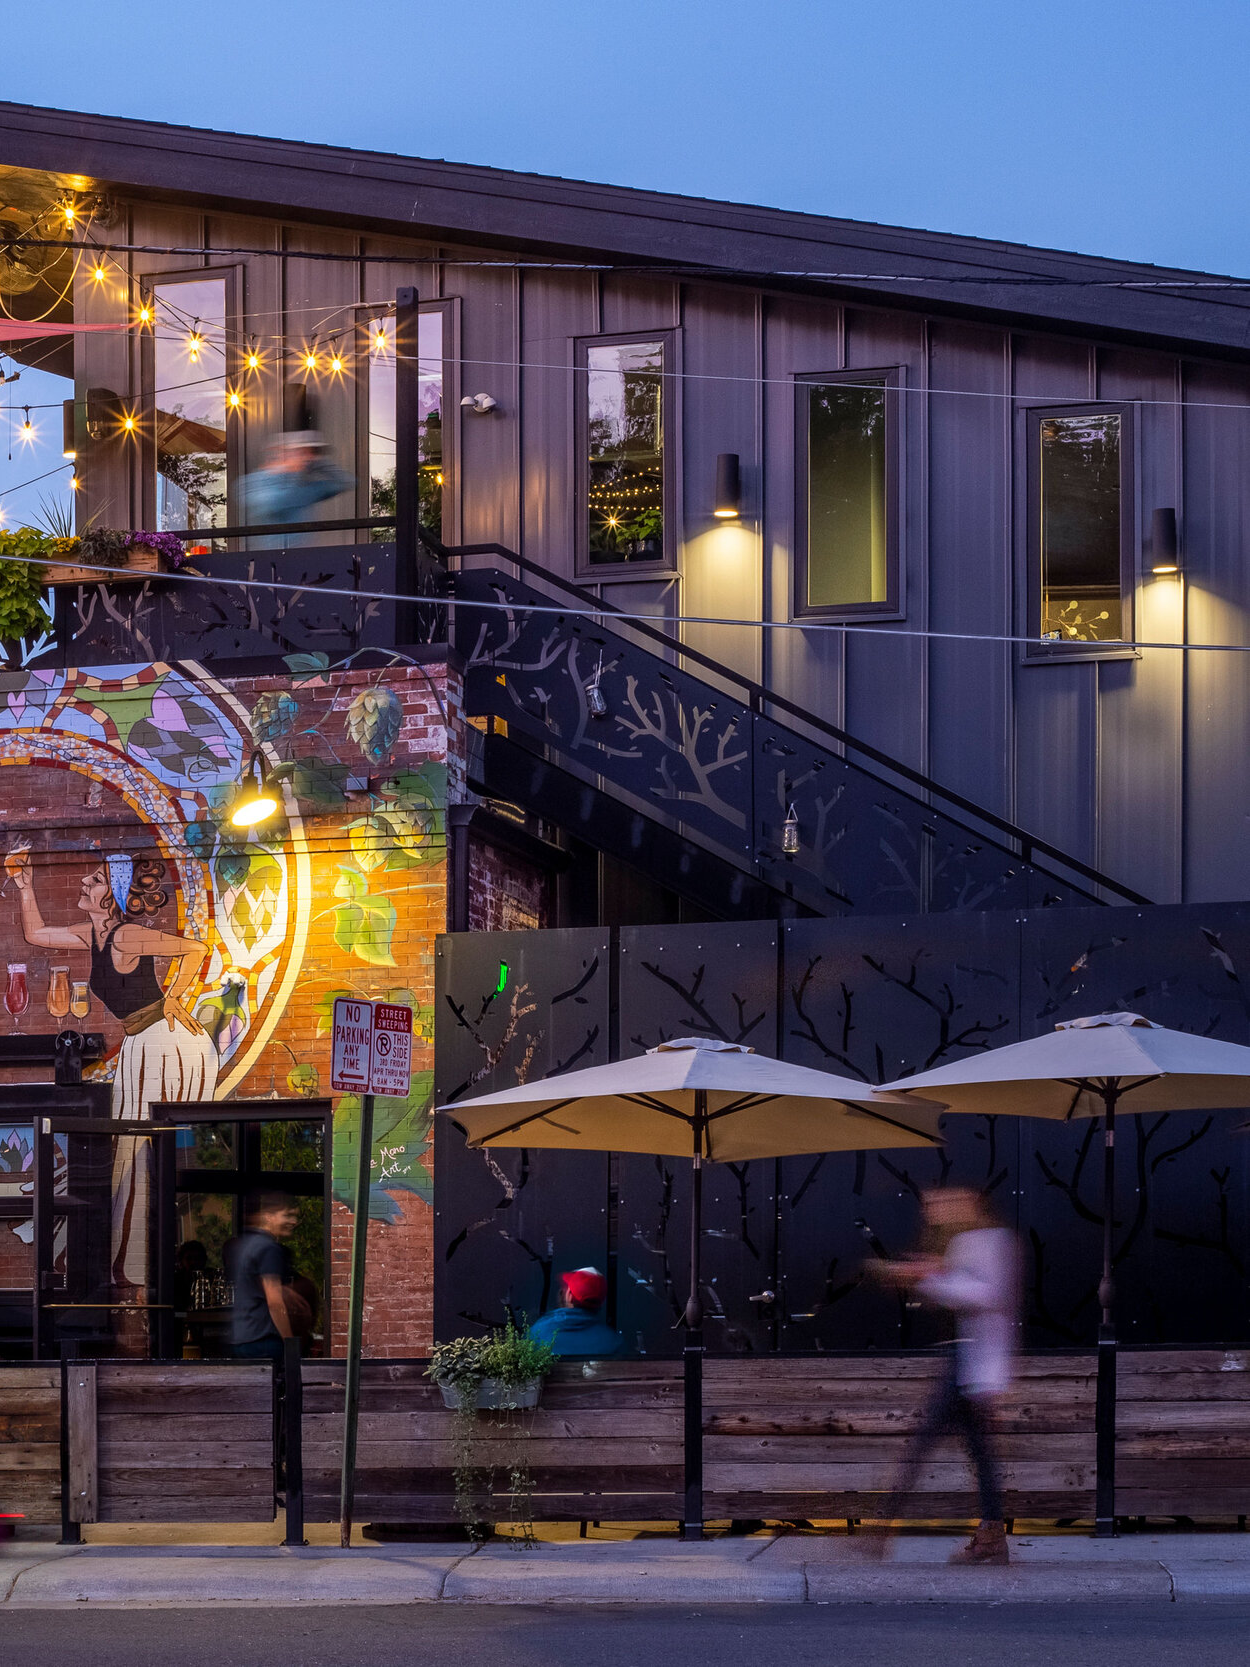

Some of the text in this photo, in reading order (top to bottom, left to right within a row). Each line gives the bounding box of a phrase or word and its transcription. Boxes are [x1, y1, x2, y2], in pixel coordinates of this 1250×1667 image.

[346, 1005, 360, 1022] NO
[380, 1008, 407, 1020] STREET
[377, 1019, 409, 1031] SWEEPING
[336, 1025, 370, 1046] PARKING
[393, 1034, 408, 1046] THIS
[344, 1045, 359, 1056] ANY
[393, 1047, 407, 1059] SIDE
[342, 1057, 360, 1071] TIME
[379, 1058, 406, 1068] 3RD FRIDAY
[373, 1067, 409, 1078] APR THRU NOV
[393, 1078, 404, 1087] 5PM
